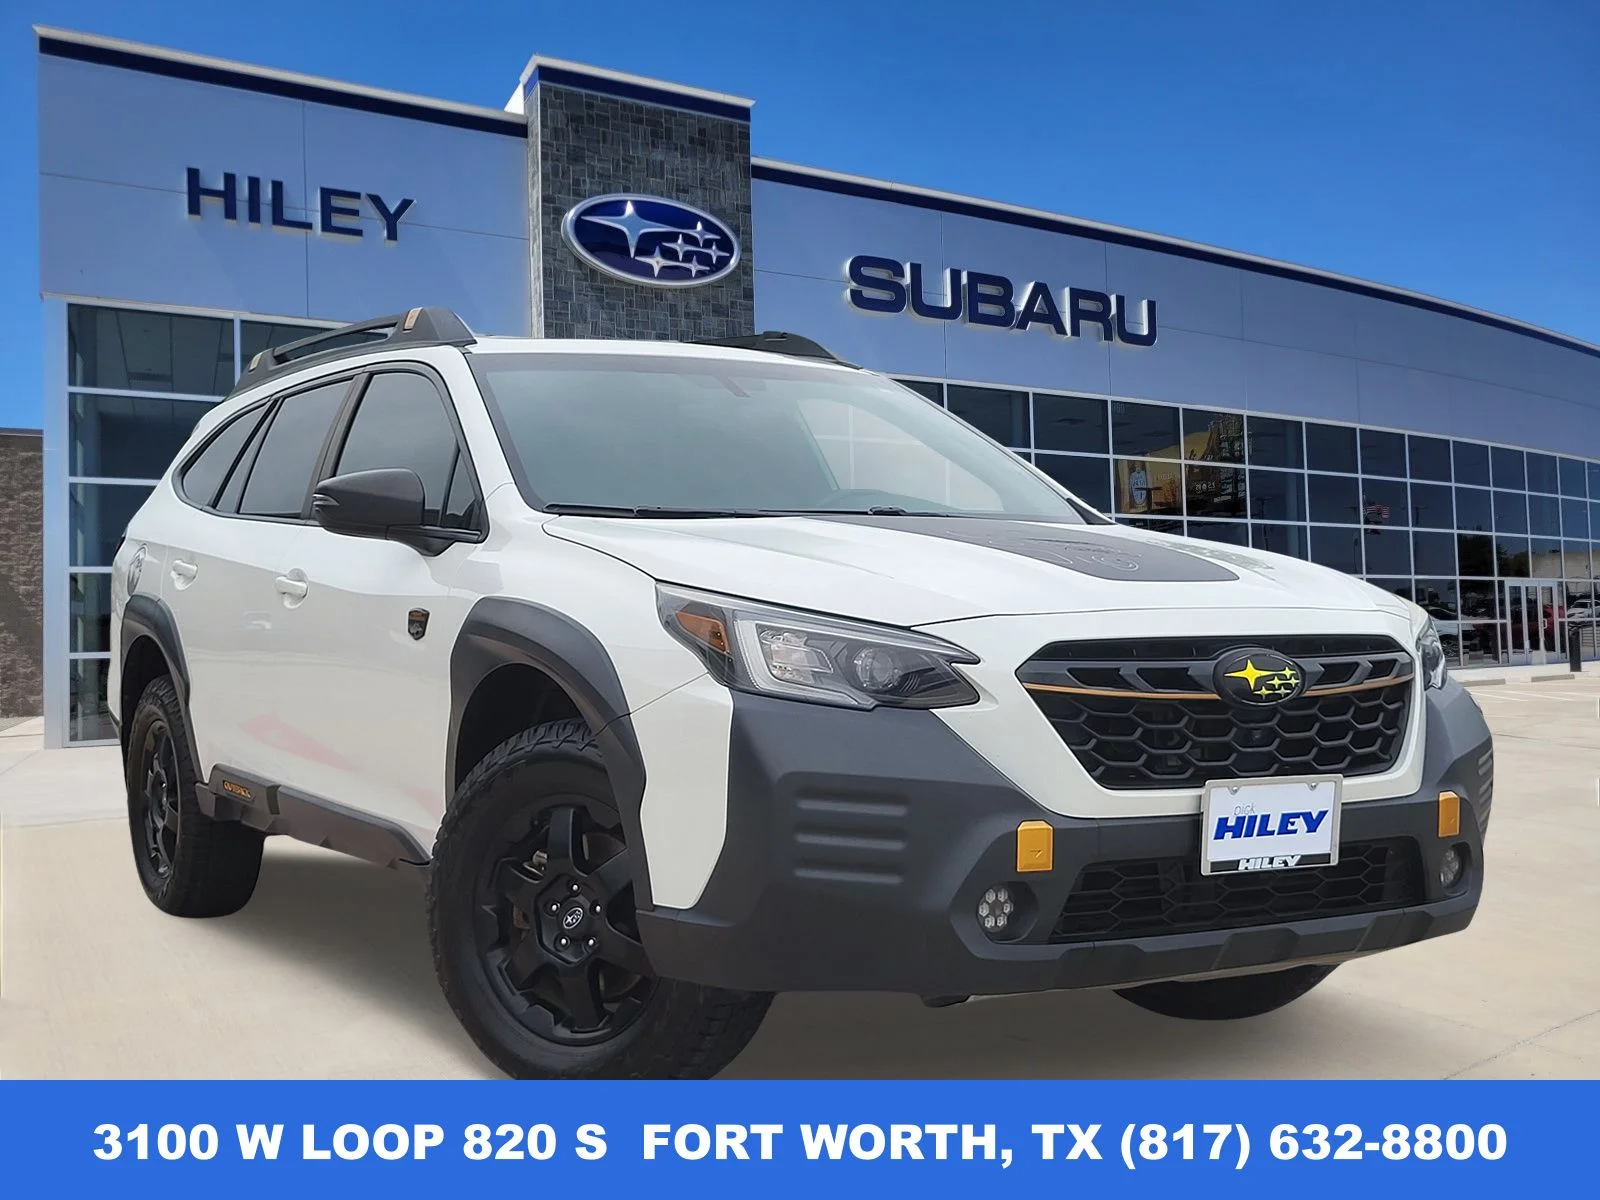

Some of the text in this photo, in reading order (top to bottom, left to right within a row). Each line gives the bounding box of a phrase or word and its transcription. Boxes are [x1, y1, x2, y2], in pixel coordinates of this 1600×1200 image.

[187, 167, 415, 241] HILEY
[846, 255, 1158, 348] SUBARU
[1213, 809, 1329, 840] HILEY
[1238, 855, 1301, 871] HILEY
